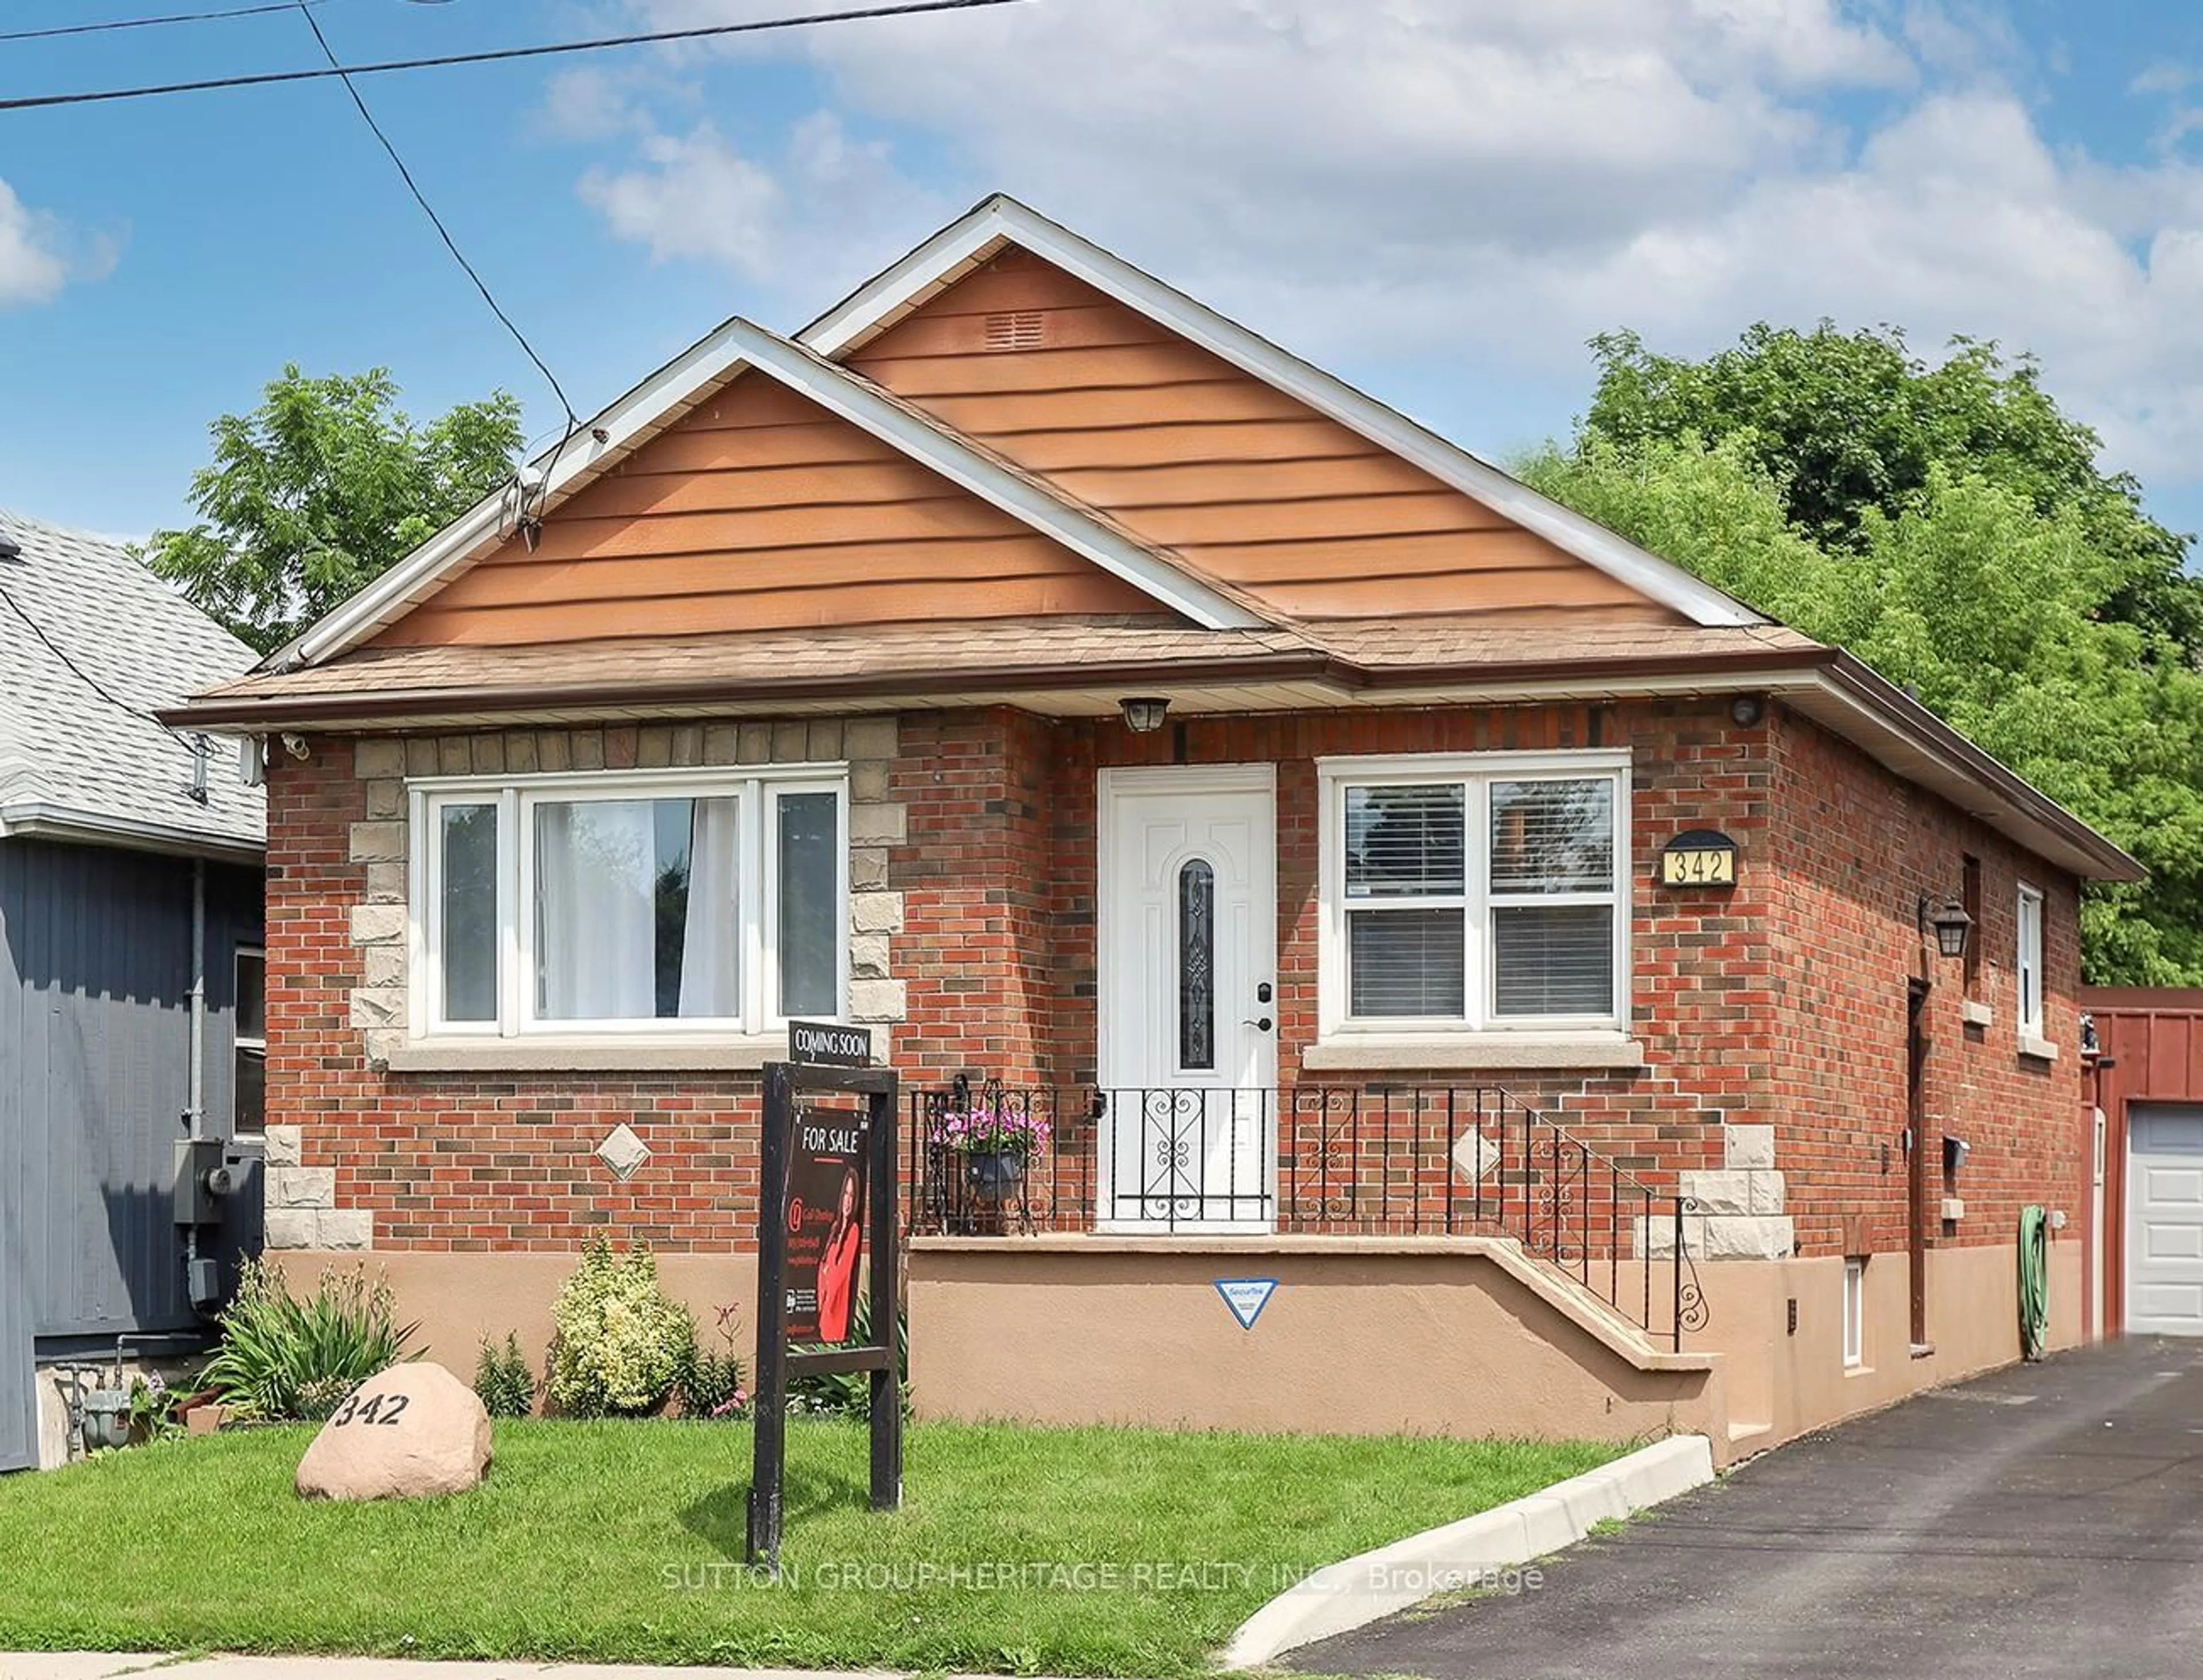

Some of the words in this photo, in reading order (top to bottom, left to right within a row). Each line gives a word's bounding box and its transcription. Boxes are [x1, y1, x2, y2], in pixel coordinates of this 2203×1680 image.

[1675, 852, 1722, 882] 342
[839, 1033, 867, 1056] SOON
[803, 1127, 826, 1151] FOR
[828, 1129, 858, 1153] SALE
[335, 1394, 408, 1427] 342
